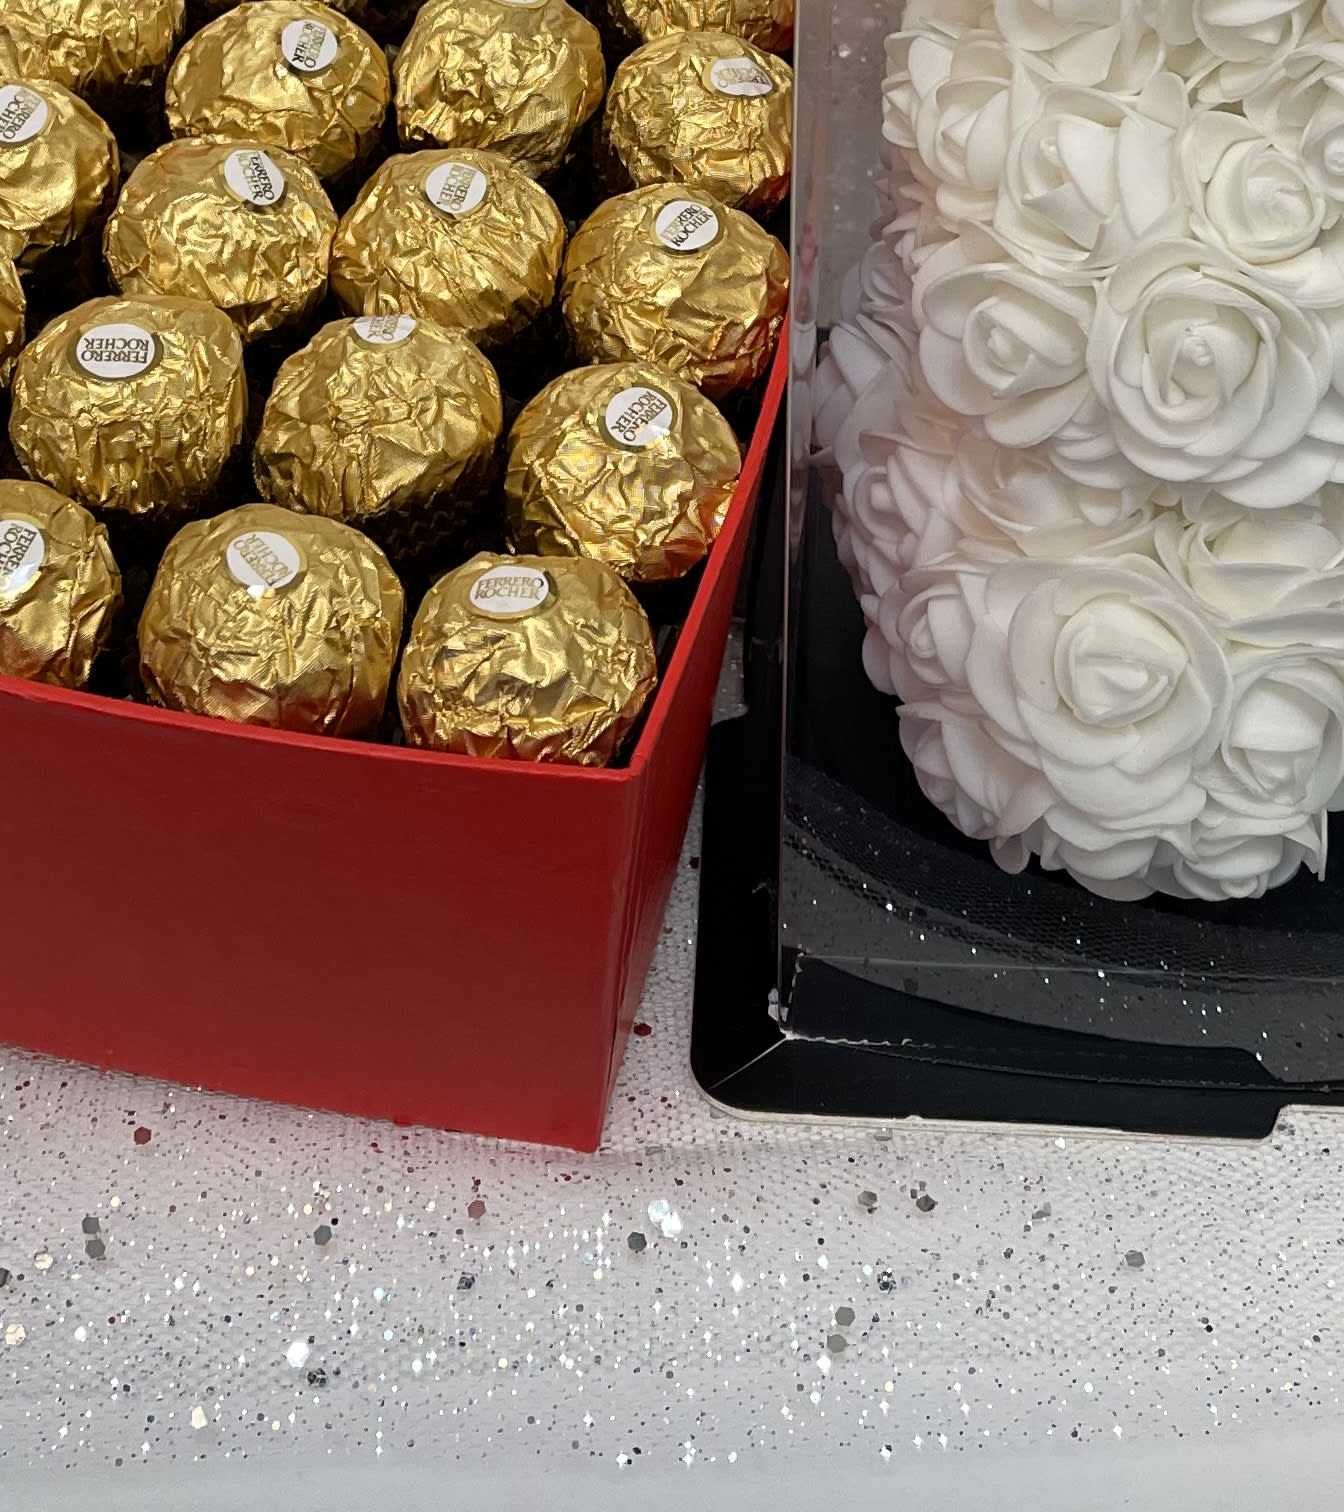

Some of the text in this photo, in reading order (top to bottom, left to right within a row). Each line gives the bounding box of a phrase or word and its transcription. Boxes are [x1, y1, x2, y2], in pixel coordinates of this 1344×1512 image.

[671, 211, 713, 248] ROCHER
[84, 338, 149, 352] ROCHER
[81, 350, 148, 364] FERRERO
[610, 391, 657, 433] ROCHER
[476, 576, 544, 589] FERRERO
[475, 587, 540, 601] ROCHER
